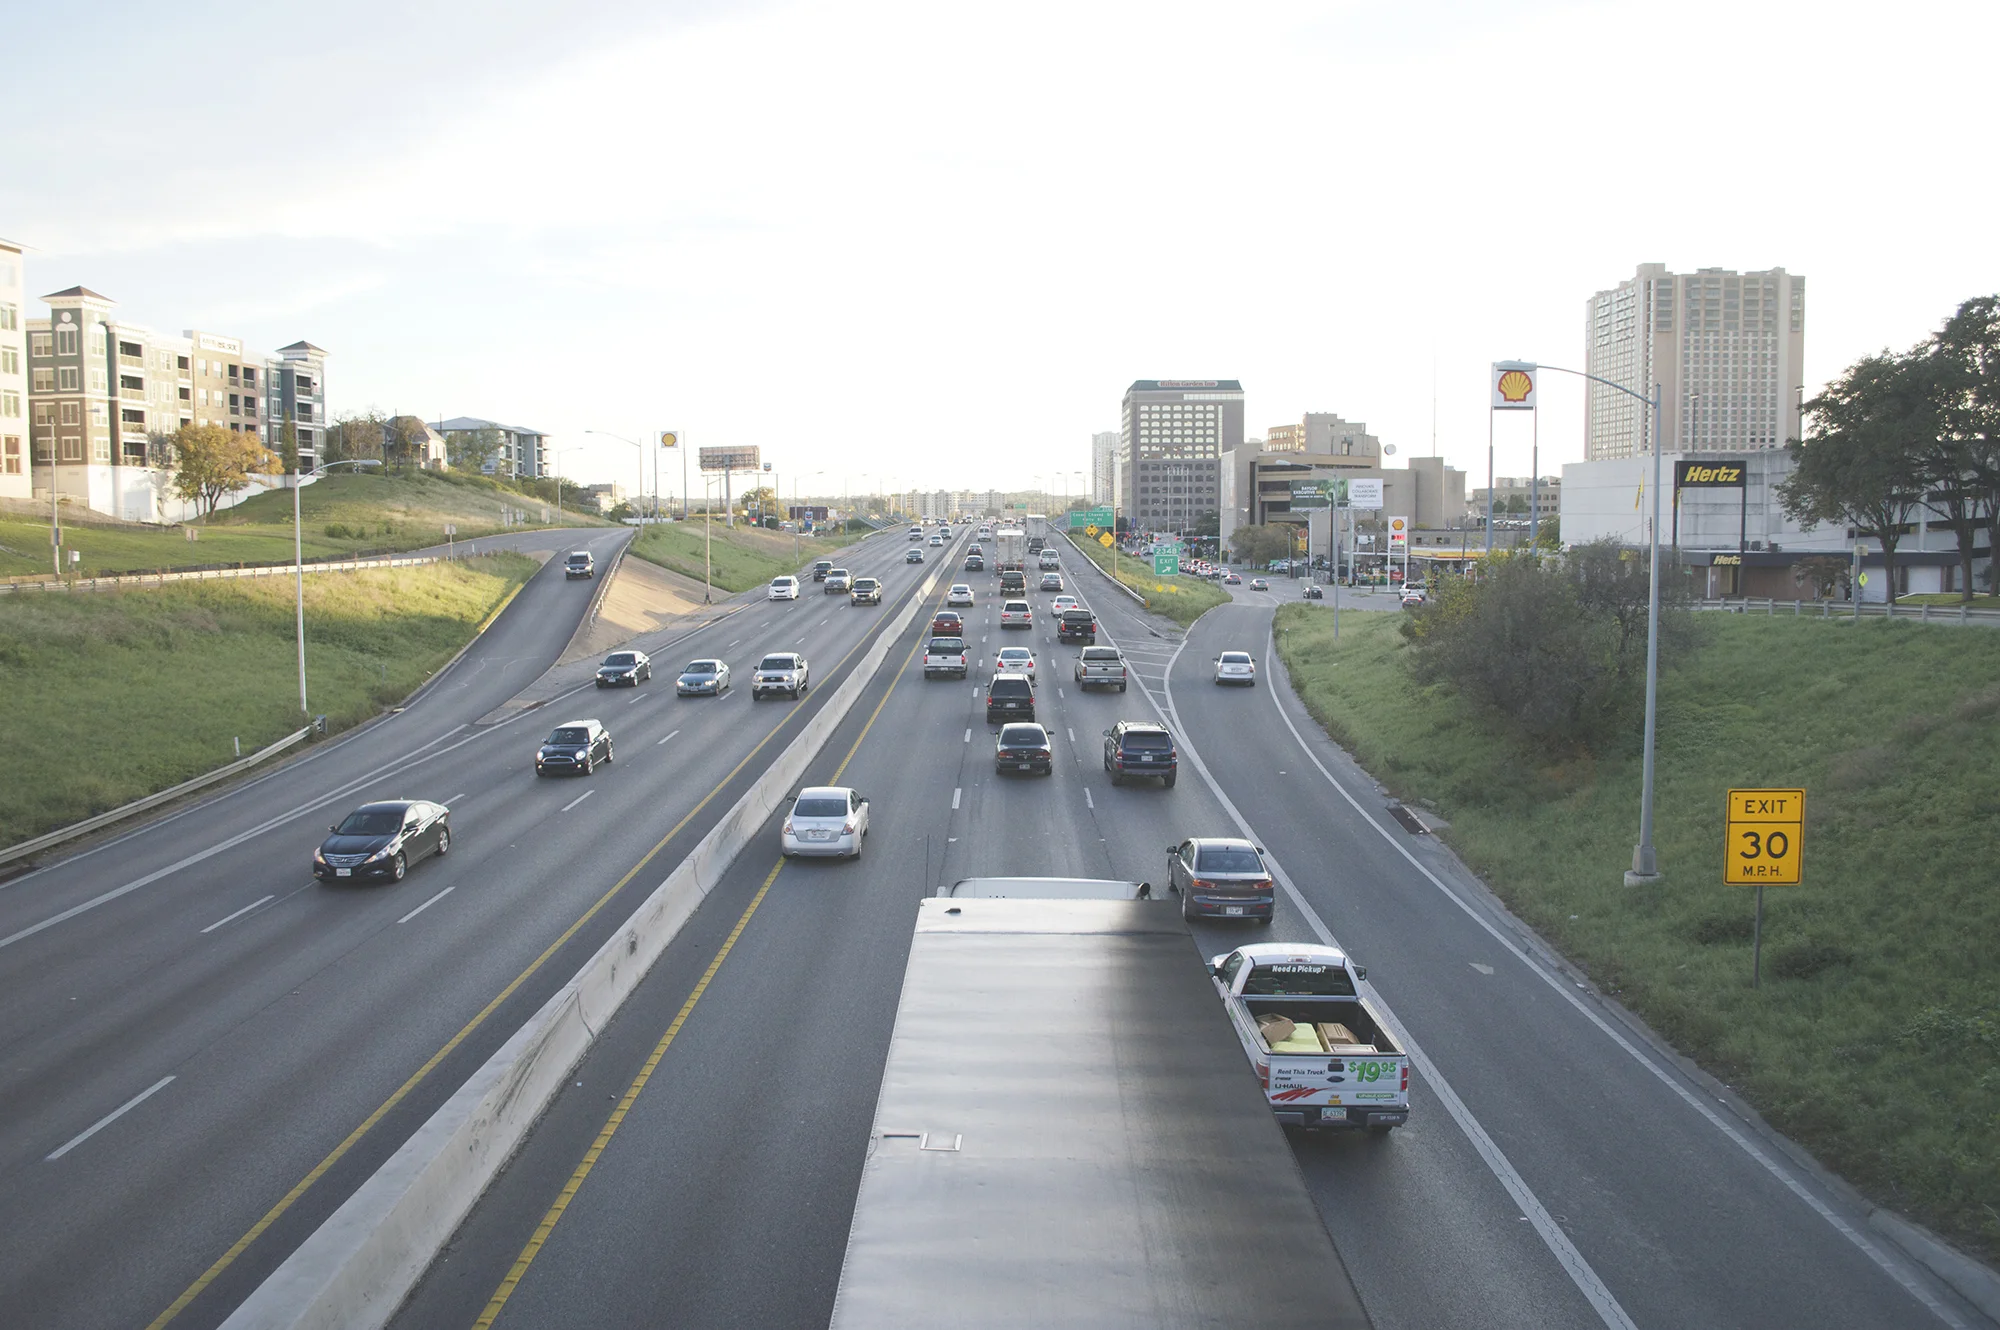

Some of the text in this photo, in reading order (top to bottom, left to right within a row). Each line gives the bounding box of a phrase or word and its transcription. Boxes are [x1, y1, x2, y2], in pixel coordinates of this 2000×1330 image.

[1685, 466, 1741, 482] Hertz
[1713, 556, 1741, 564] Hertz
[1745, 800, 1787, 814] EXIT
[1740, 831, 1789, 859] 30
[1272, 965, 1292, 973] Need
[1297, 966, 1326, 974] Pickup?
